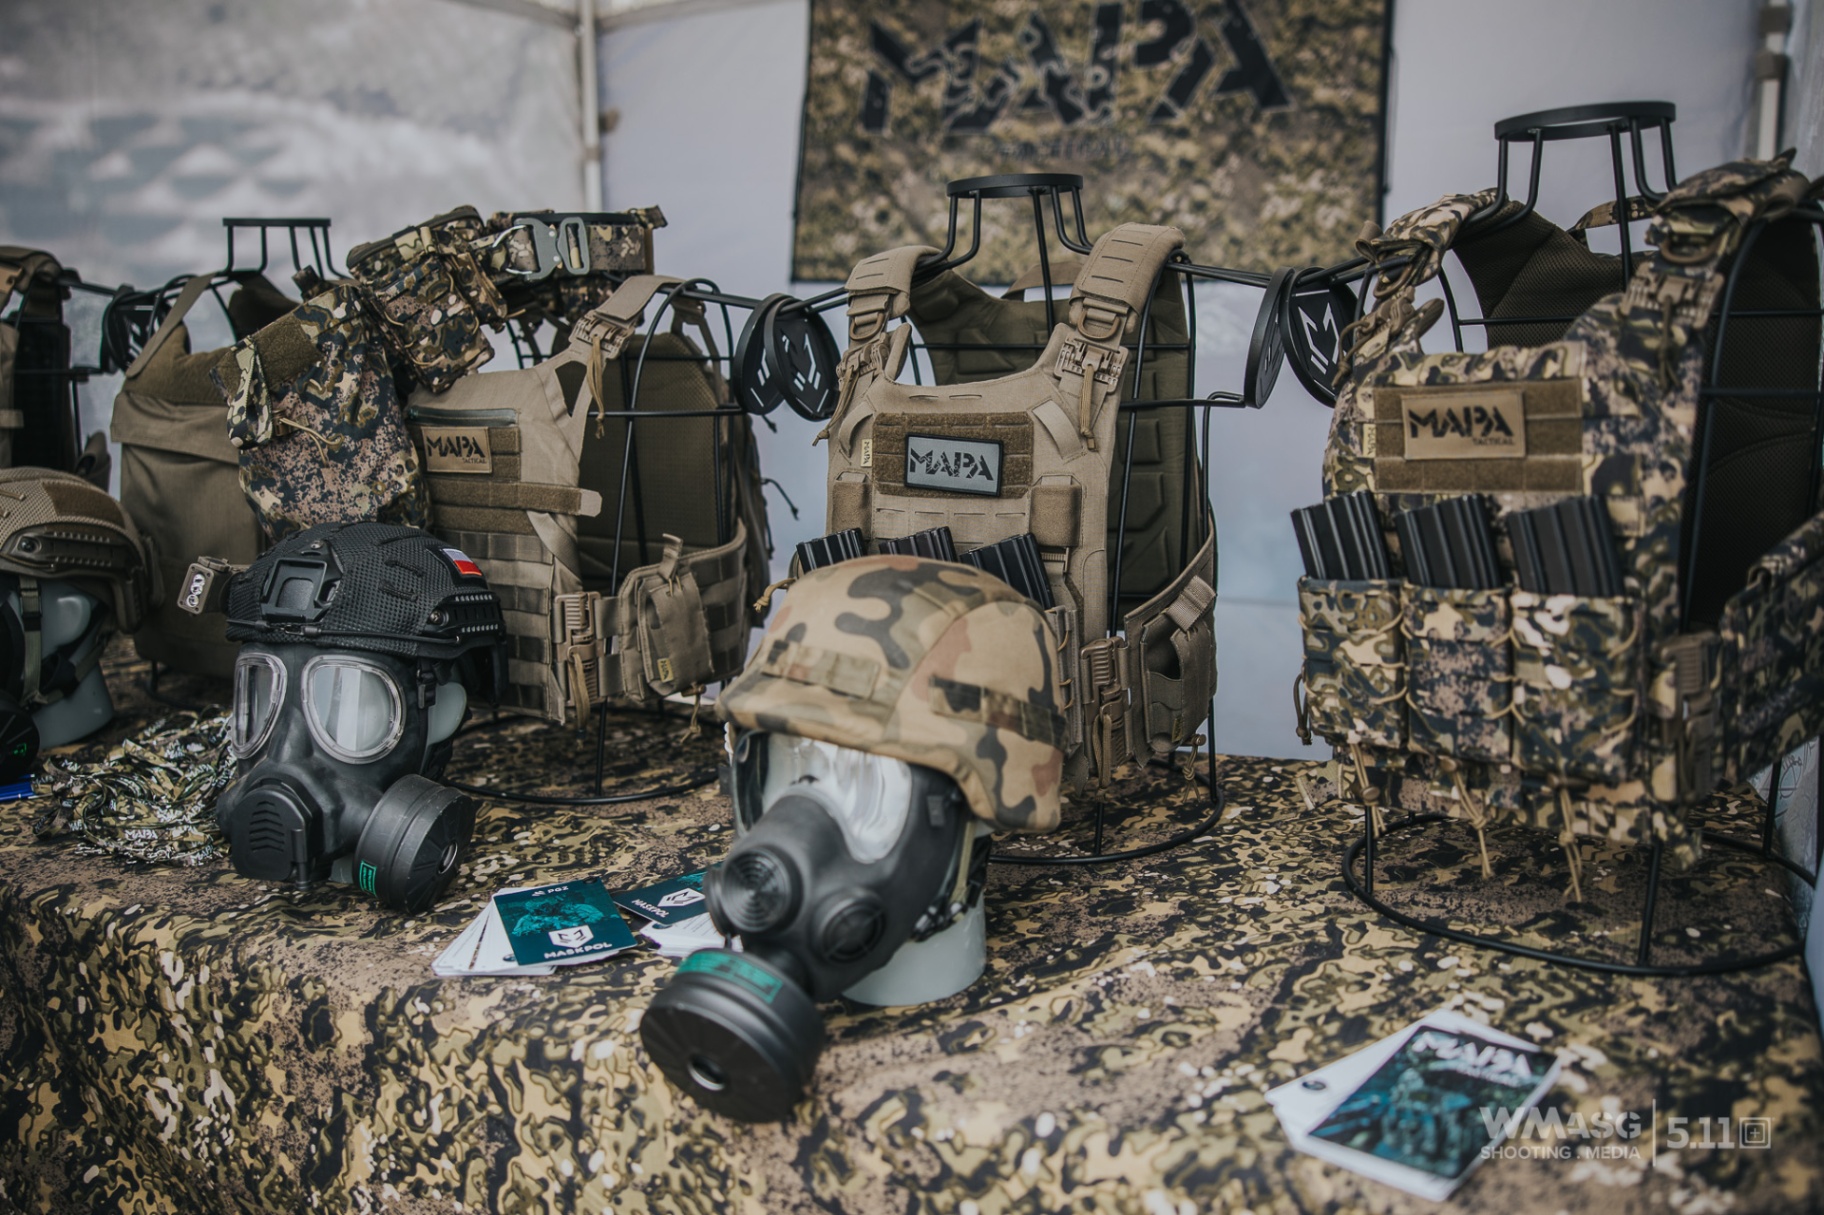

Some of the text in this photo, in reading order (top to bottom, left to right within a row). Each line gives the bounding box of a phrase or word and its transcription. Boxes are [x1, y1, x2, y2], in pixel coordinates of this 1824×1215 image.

[861, 0, 1298, 137] MAPA
[1408, 406, 1514, 438] MAPA
[426, 436, 486, 458] MAPA
[863, 441, 871, 464] MAPA
[909, 447, 994, 481] MAPA
[125, 828, 158, 840] MAPA
[631, 898, 670, 918] MASKPOL
[544, 941, 613, 959] MASKPOL
